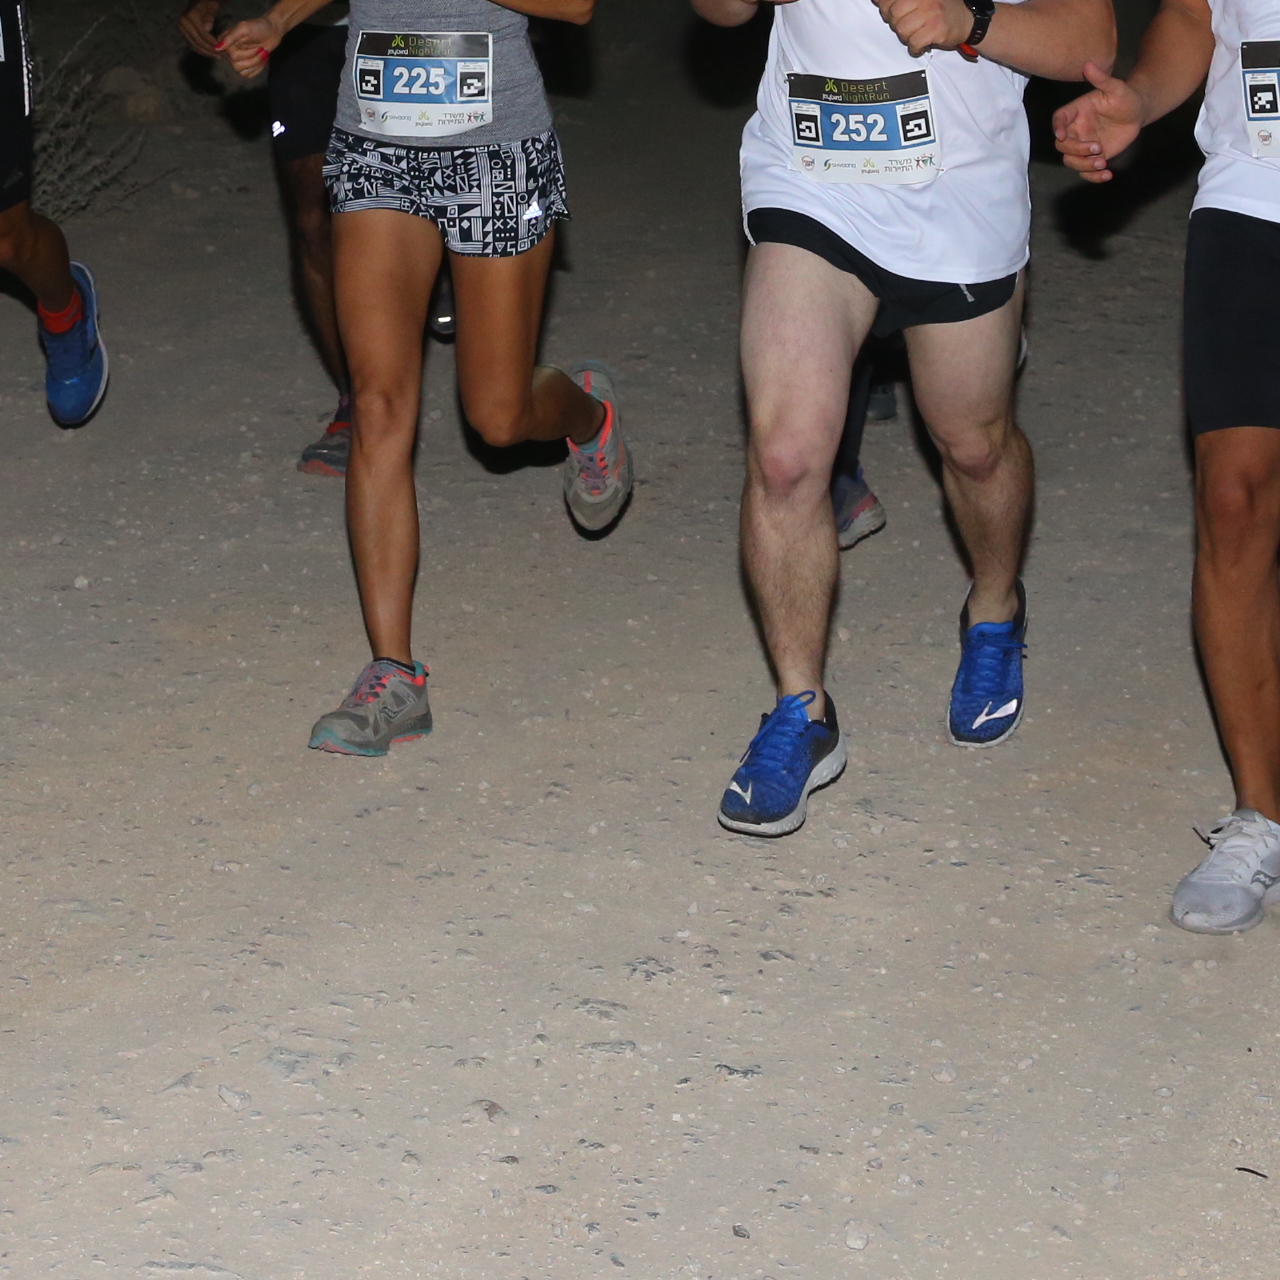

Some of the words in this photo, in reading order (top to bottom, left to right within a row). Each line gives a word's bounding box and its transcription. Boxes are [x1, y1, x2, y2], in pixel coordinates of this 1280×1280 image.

[409, 36, 453, 47] Desert
[393, 66, 446, 95] 225
[841, 81, 888, 93] Desert
[842, 92, 890, 103] NightRun
[830, 112, 888, 142] 252
